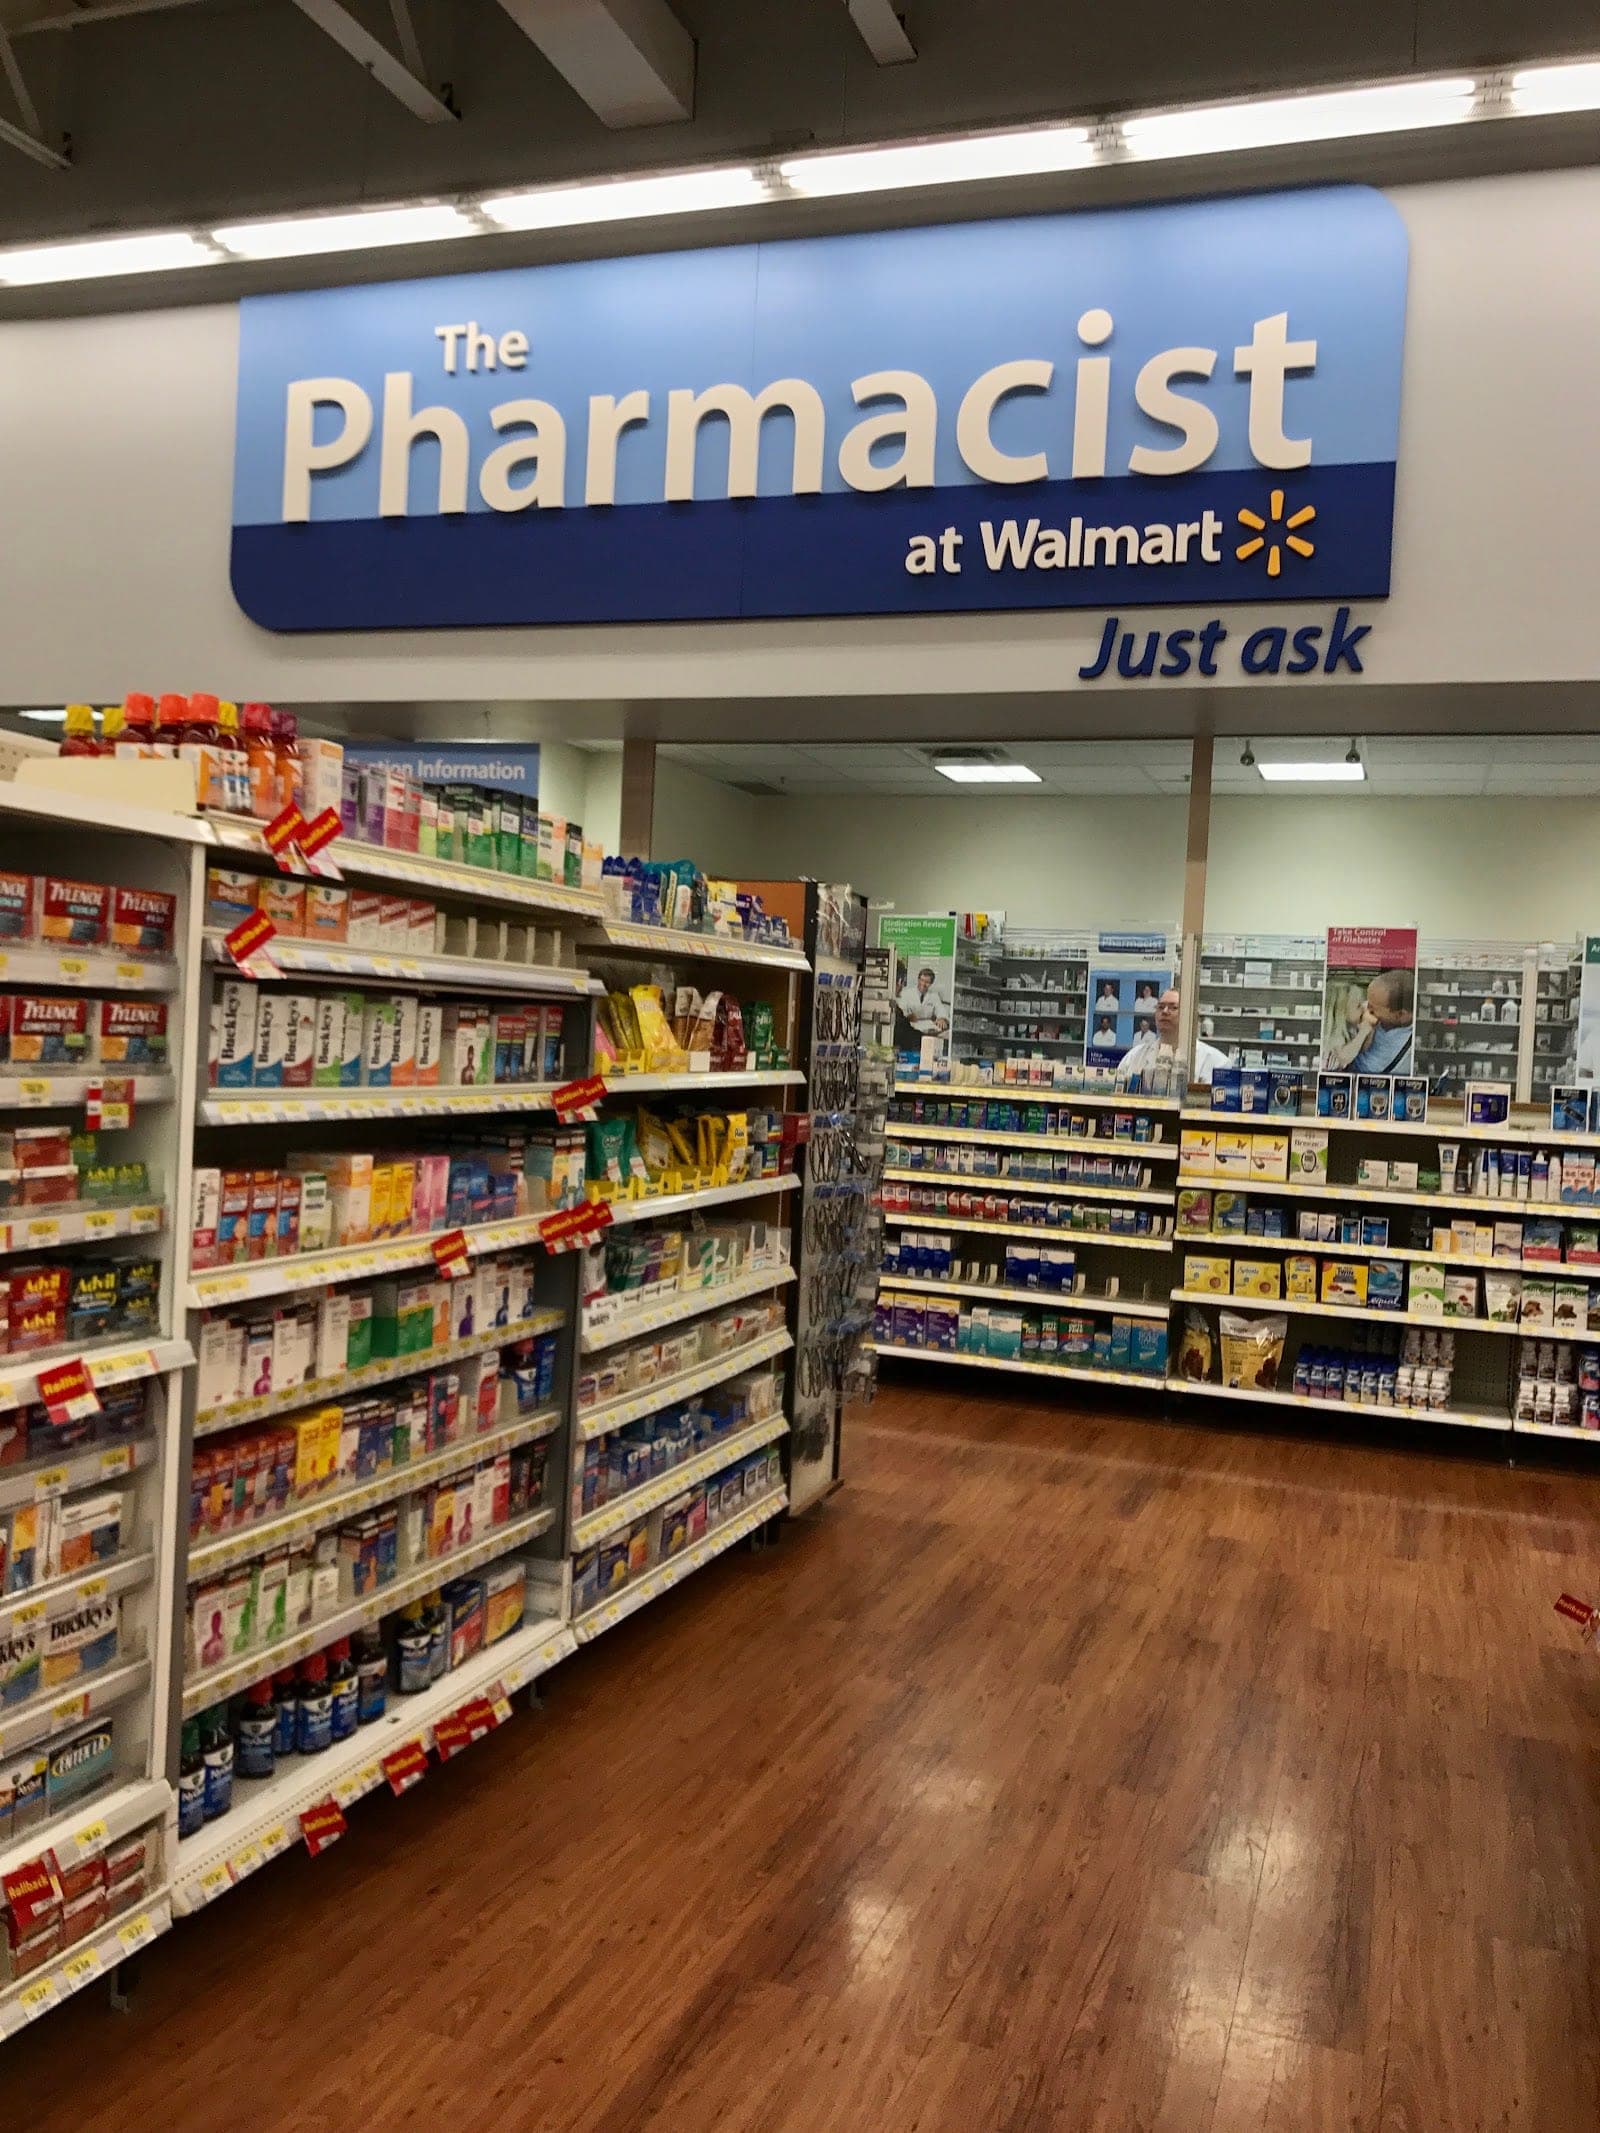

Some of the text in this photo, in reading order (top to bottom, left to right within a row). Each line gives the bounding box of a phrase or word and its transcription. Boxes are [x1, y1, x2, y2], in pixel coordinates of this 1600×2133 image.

[435, 321, 529, 374] The
[282, 308, 1318, 522] Pharmacist
[905, 510, 1222, 575] at Walmart
[1078, 606, 1373, 679] Just ask
[417, 758, 526, 780] Information
[50, 882, 104, 906] TYLENOL
[121, 891, 170, 914] TYLENOL
[1343, 936, 1381, 945] Diabetes
[1354, 928, 1387, 937] Control
[23, 1000, 79, 1021] TYLENOL
[109, 1002, 160, 1022] TYLENOL
[25, 1272, 61, 1293] Advil
[78, 1272, 117, 1293] Advil
[22, 1310, 56, 1330] Advil
[8, 1875, 49, 1900] Rollback
